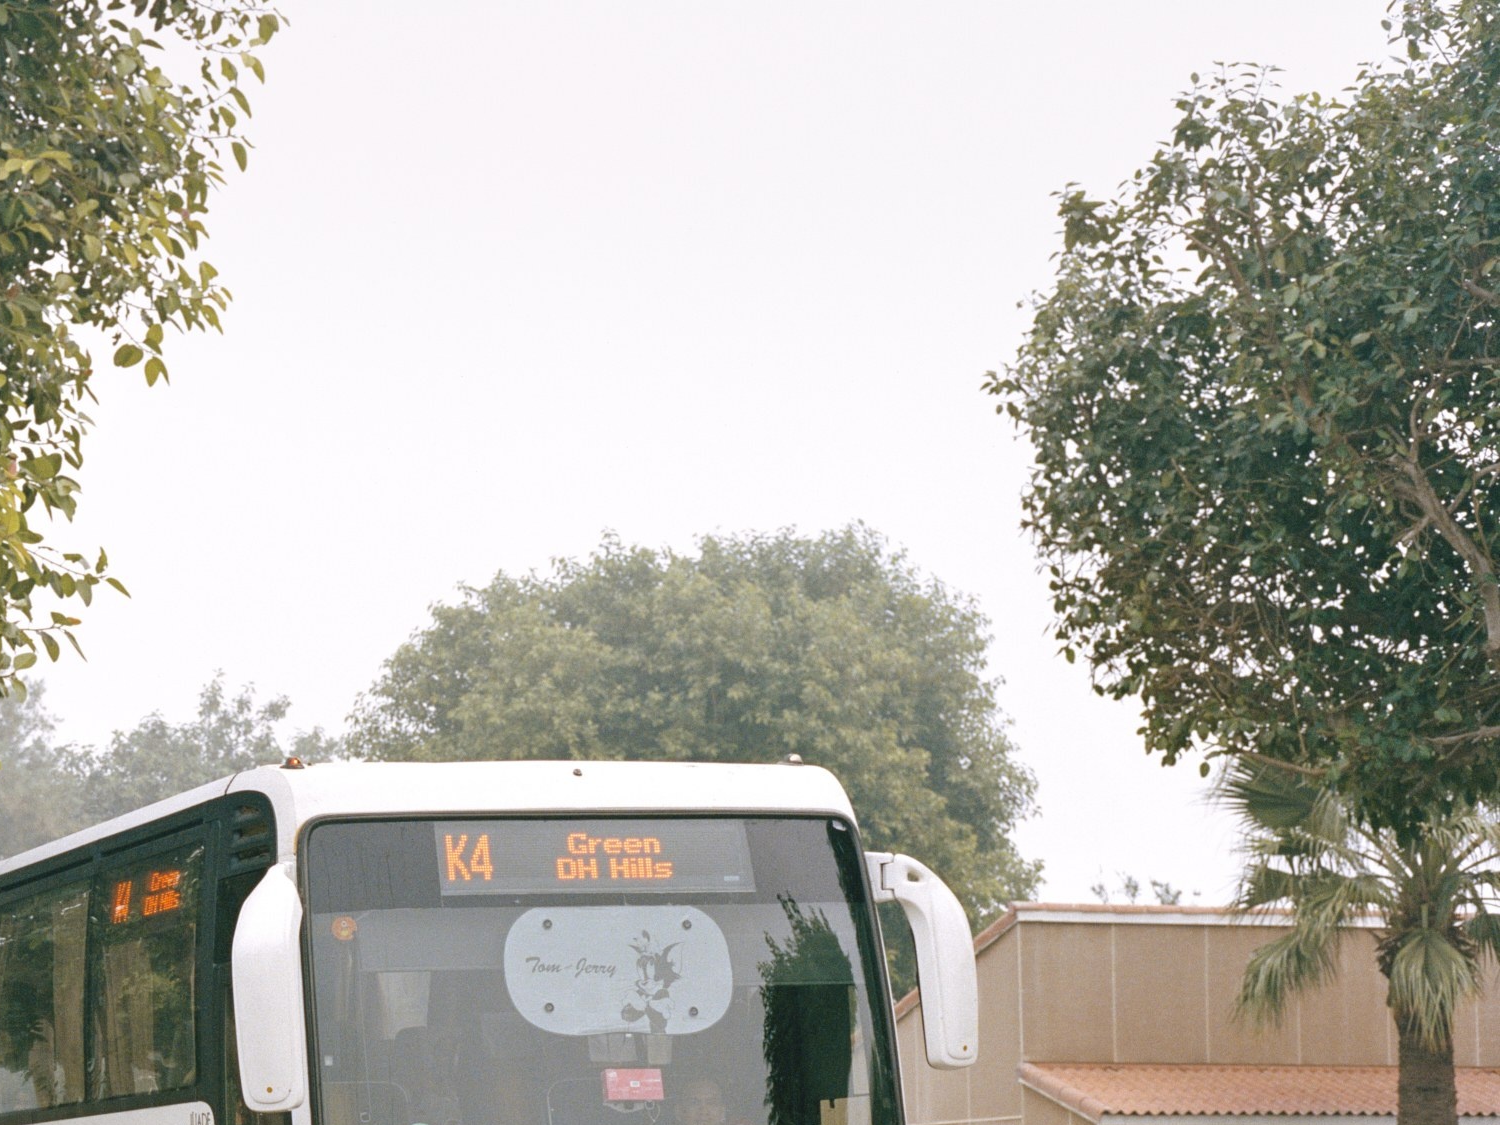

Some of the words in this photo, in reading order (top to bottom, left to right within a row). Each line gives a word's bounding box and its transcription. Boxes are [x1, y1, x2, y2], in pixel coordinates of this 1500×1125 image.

[567, 832, 661, 854] Green
[444, 833, 493, 881] K4
[556, 857, 599, 880] DH
[610, 856, 673, 879] Hills
